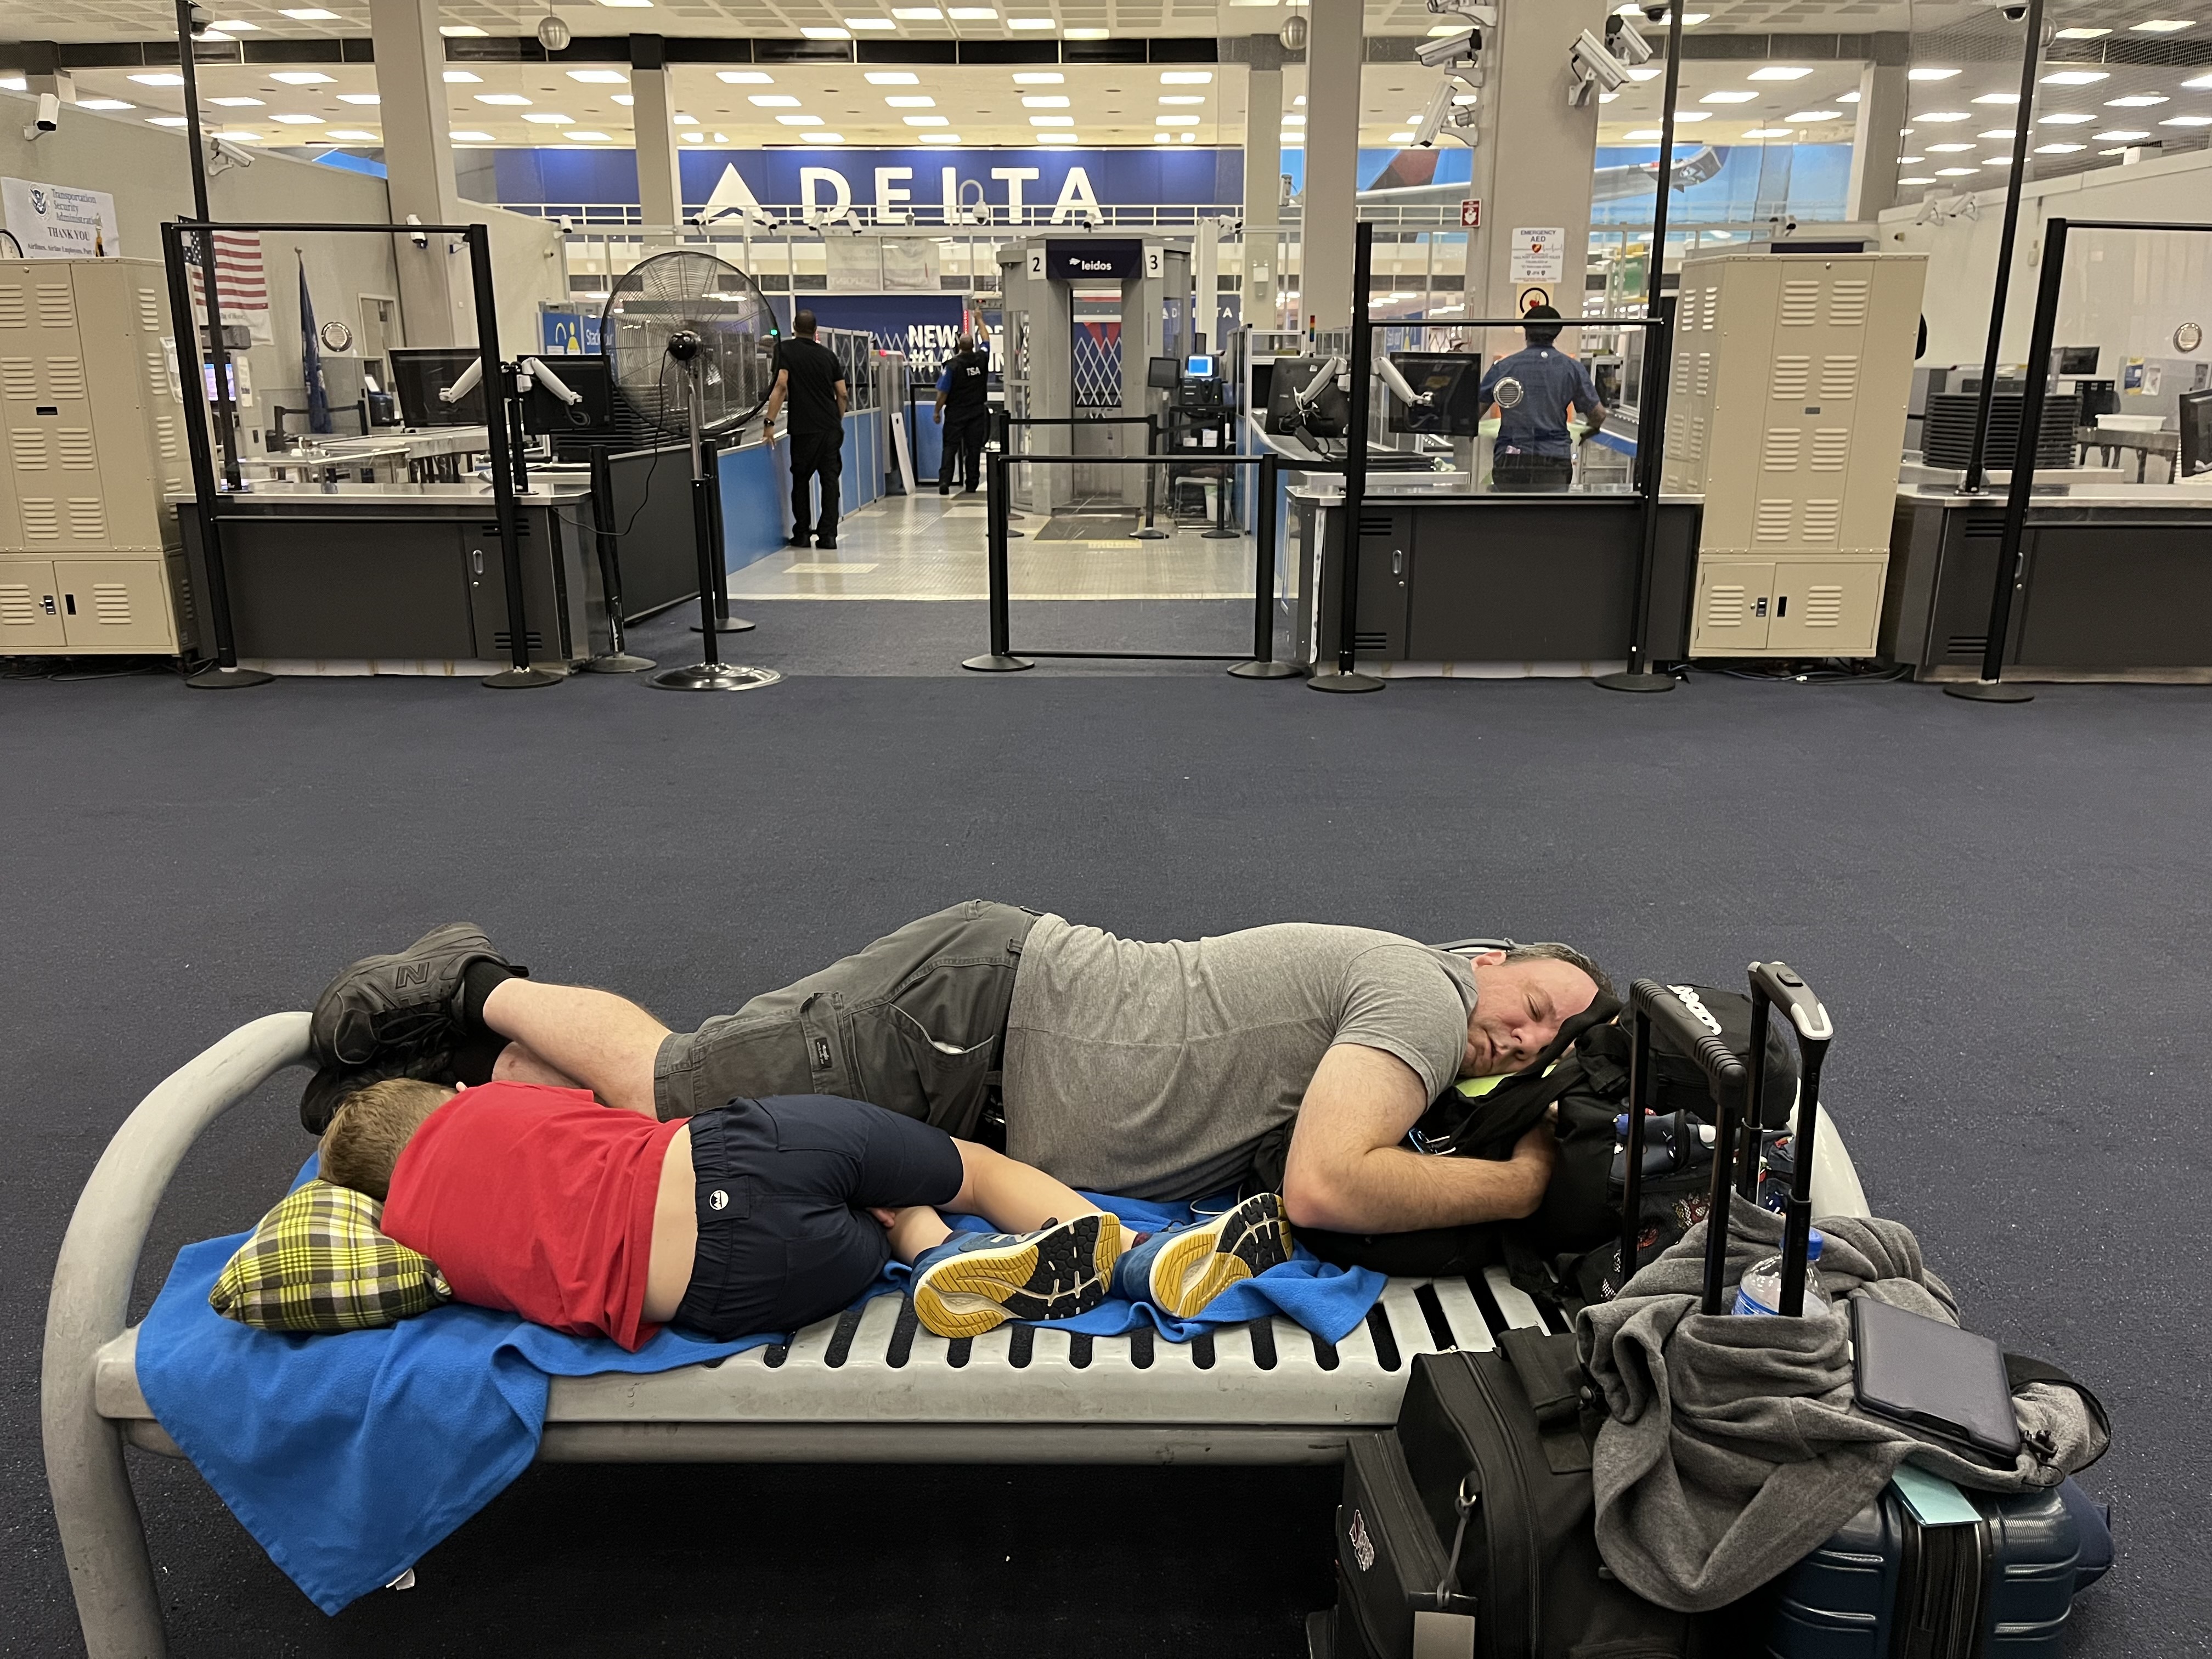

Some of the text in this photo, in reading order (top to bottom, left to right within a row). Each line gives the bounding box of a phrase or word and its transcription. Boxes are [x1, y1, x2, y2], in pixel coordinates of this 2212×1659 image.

[52, 189, 97, 204] Transportation
[800, 167, 1104, 225] DELTA
[54, 200, 78, 216] Security
[57, 212, 96, 225] Administrati
[48, 227, 90, 241] THANK YOU
[1032, 257, 1041, 272] 2
[1081, 260, 1112, 270] leidos
[1149, 255, 1158, 270] 3
[908, 325, 959, 348] NEW
[966, 366, 981, 376] TSA
